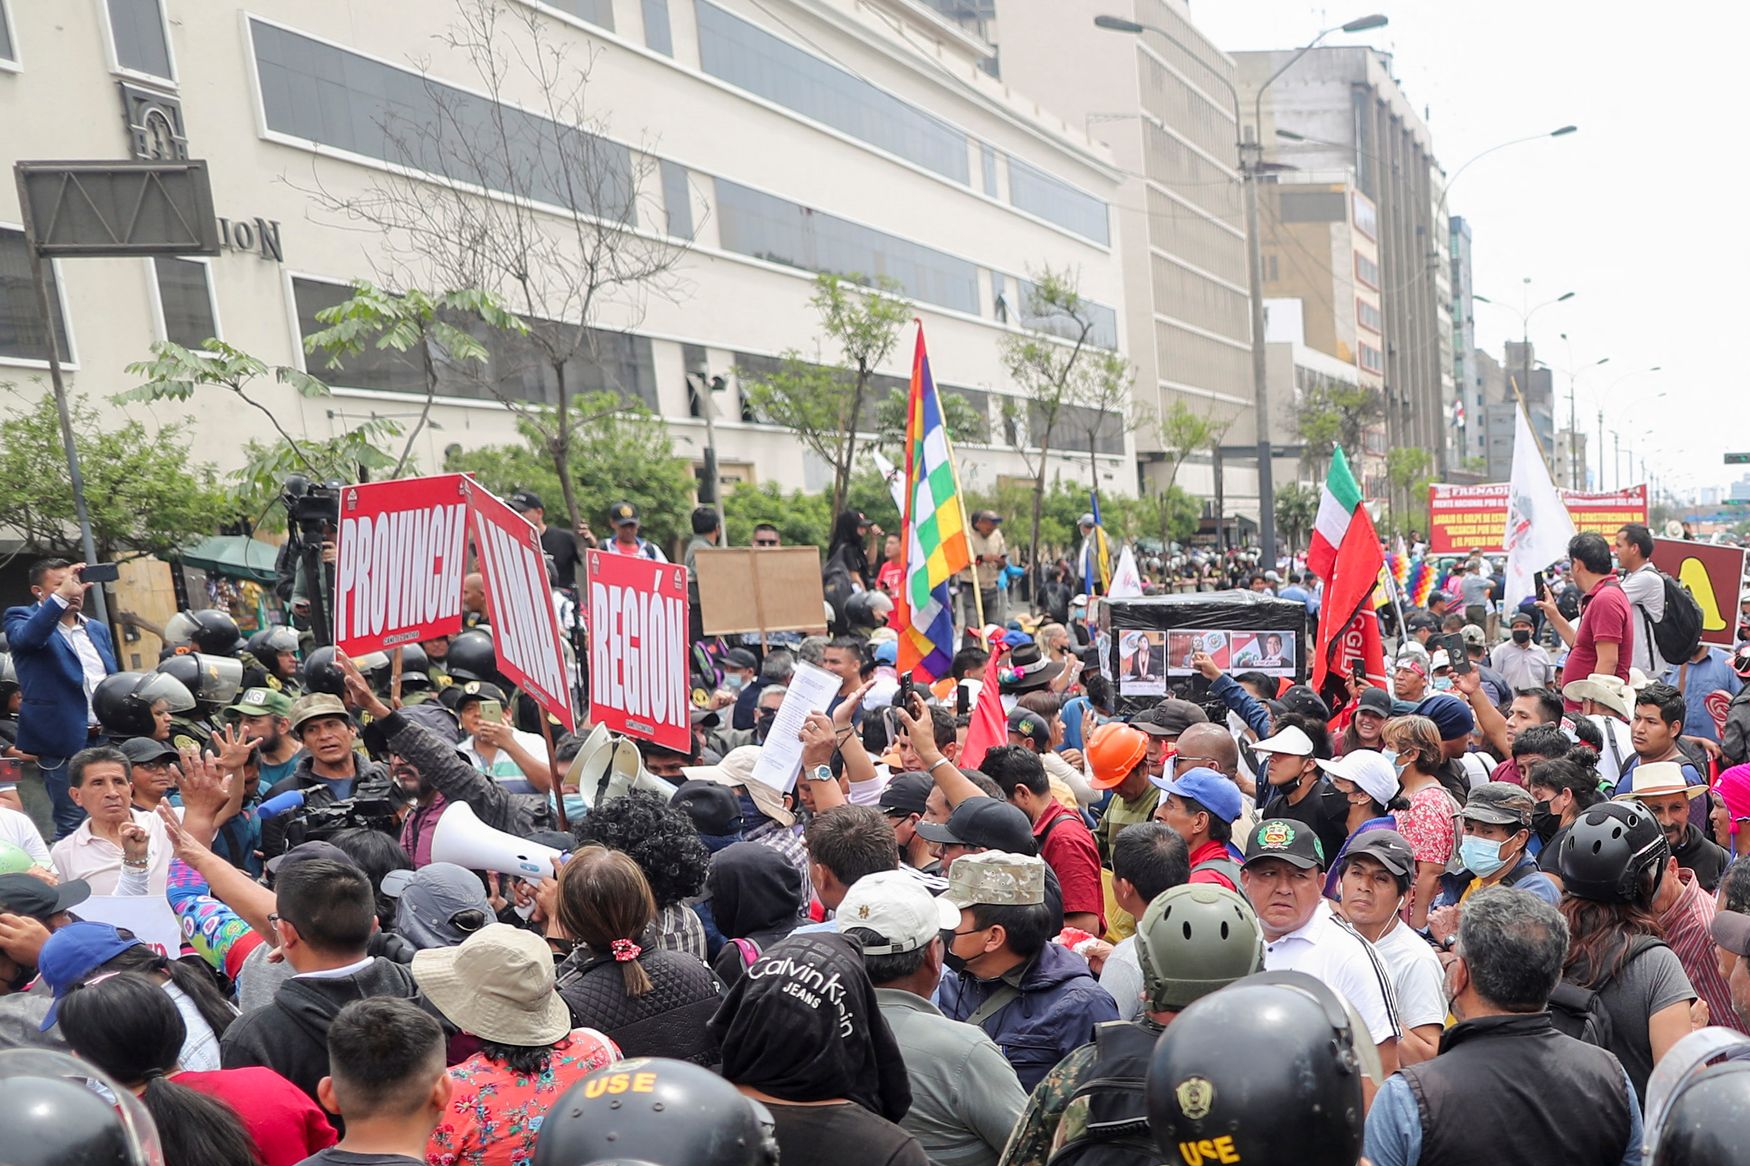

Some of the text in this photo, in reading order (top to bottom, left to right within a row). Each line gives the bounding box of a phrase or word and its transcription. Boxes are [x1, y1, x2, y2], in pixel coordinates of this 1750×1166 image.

[338, 503, 466, 642] PROVINCIA
[474, 509, 567, 709] LIMA
[592, 569, 685, 729] REGIÓN
[748, 956, 824, 990] Calvin
[782, 982, 822, 1009] JEANS
[585, 1072, 657, 1099] USE
